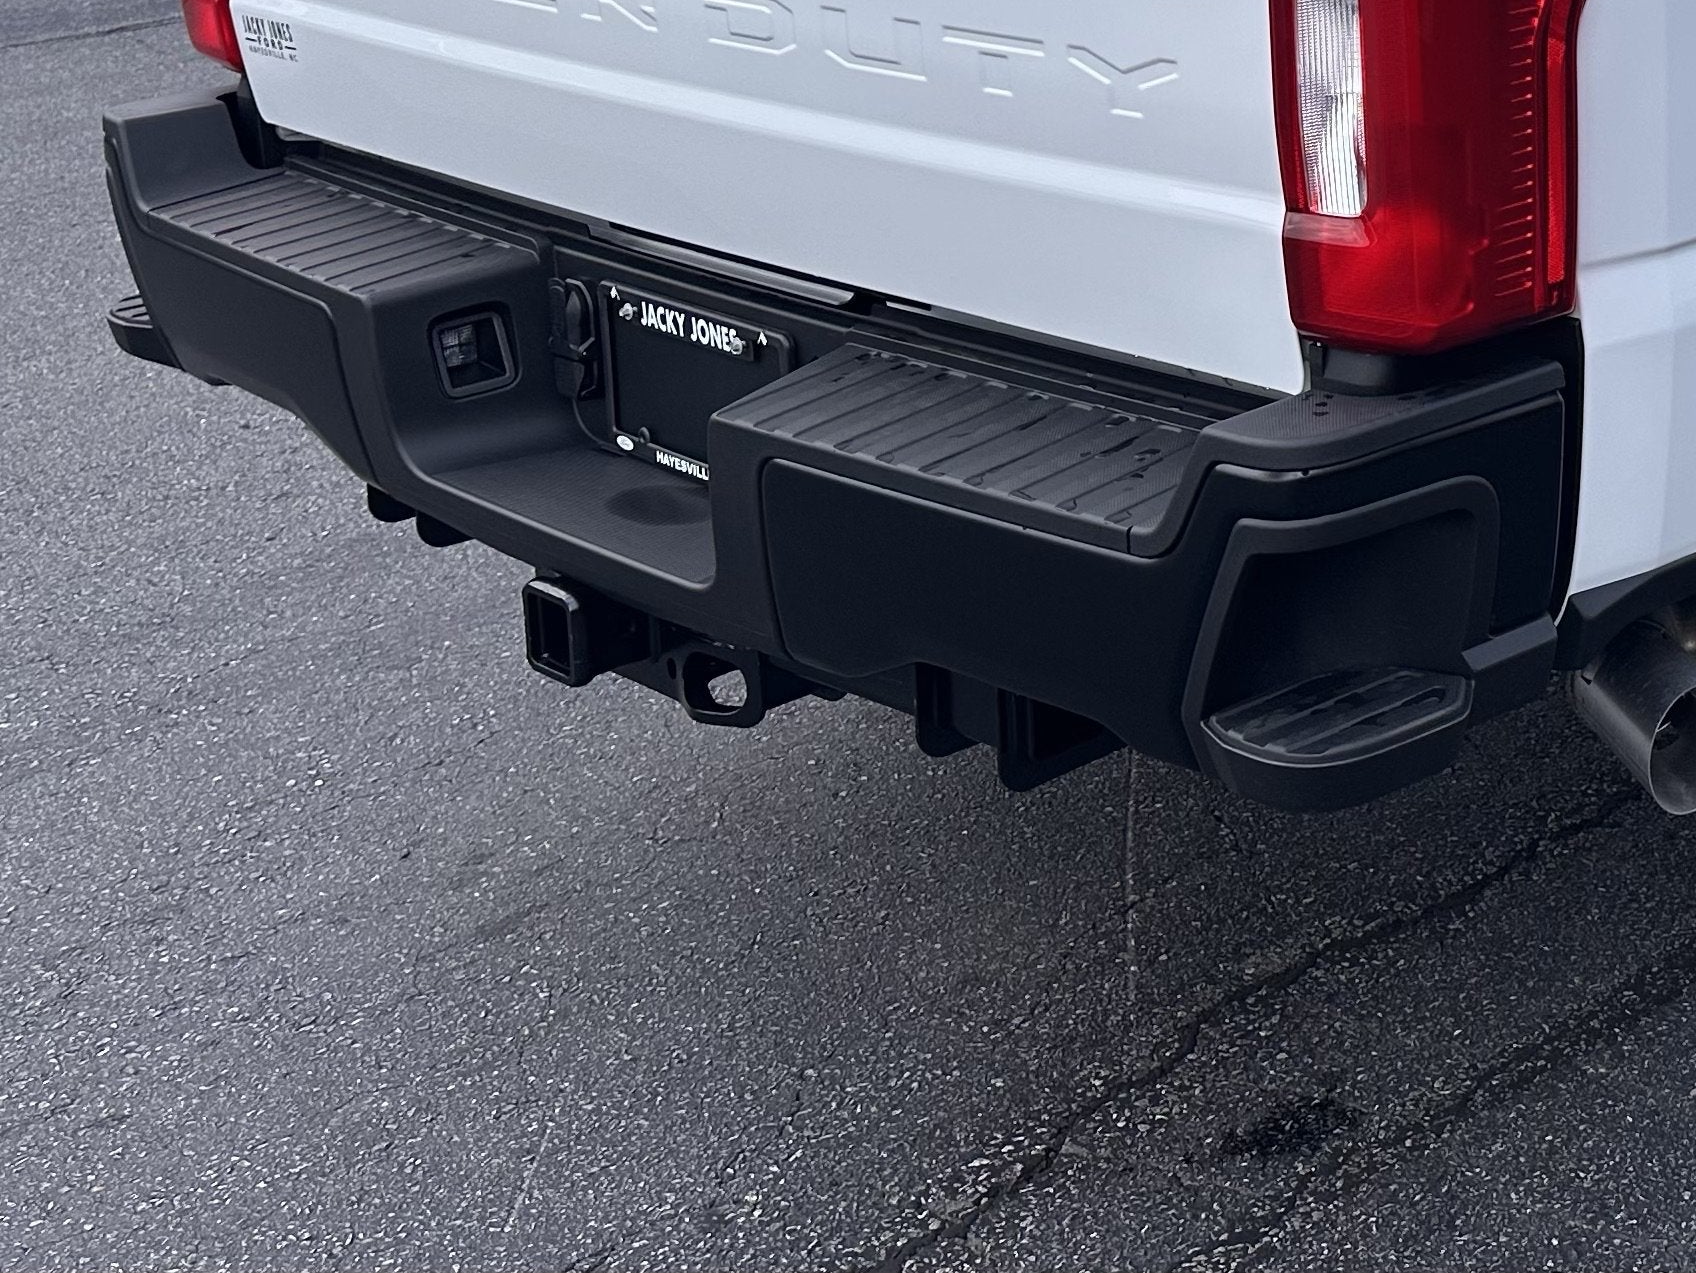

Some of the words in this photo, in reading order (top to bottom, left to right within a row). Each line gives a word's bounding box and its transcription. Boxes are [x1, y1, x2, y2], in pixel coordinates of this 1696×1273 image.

[241, 14, 267, 37] JACKY
[267, 19, 293, 43] JONES
[256, 35, 284, 51] FORD
[640, 301, 685, 338] JACKY
[656, 450, 710, 481] HAYESVILL
